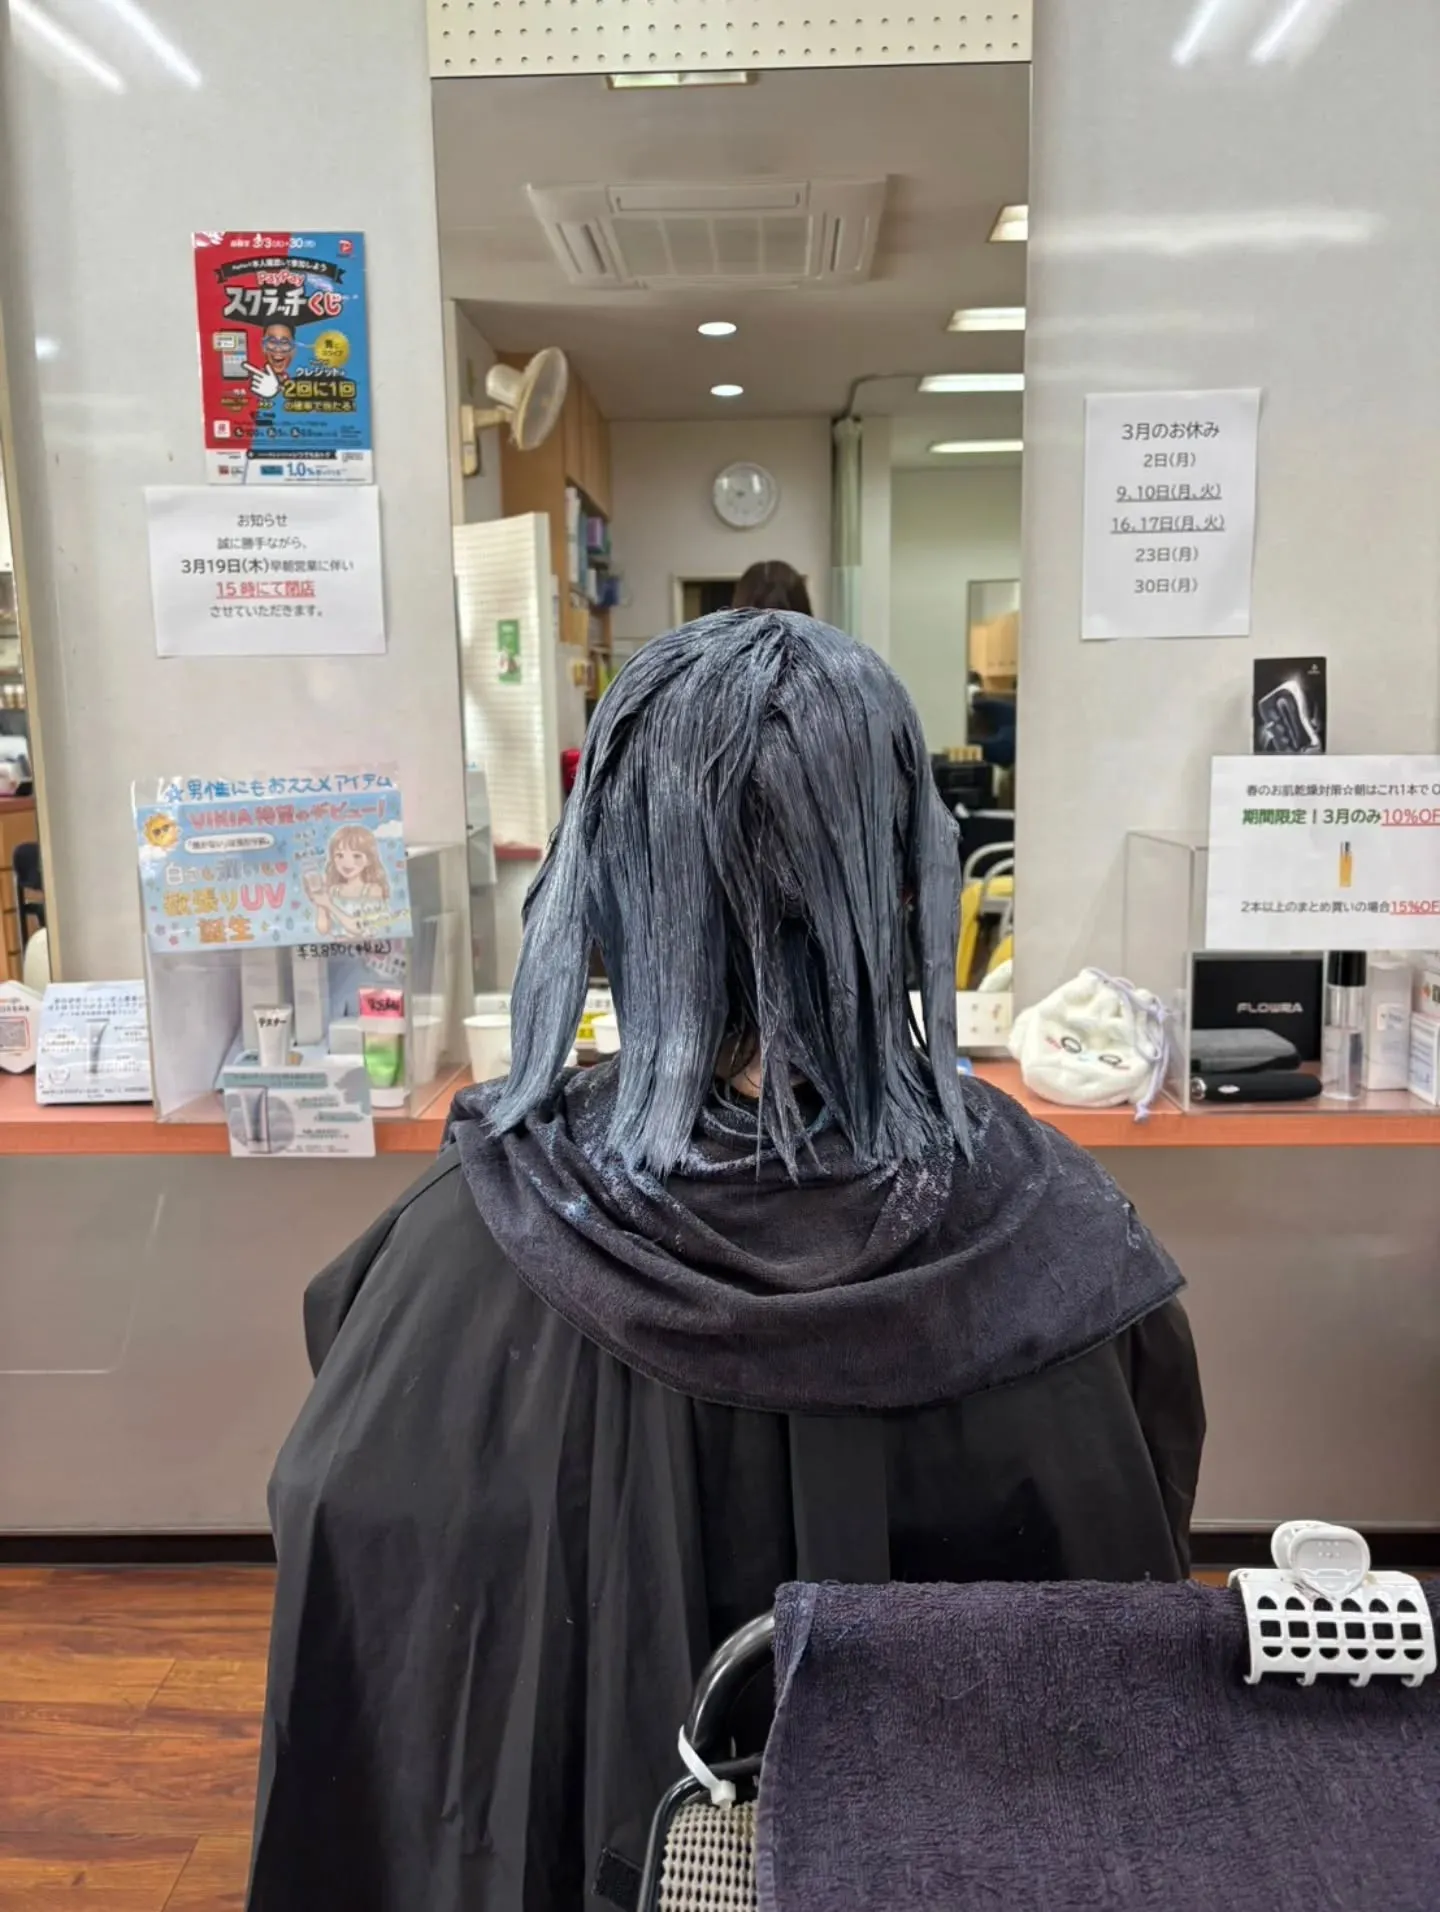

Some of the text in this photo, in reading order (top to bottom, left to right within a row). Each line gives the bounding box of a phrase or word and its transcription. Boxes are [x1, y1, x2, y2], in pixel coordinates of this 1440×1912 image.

[256, 270, 305, 288] PayPay
[223, 286, 343, 318] スクラッチくじ
[1121, 421, 1220, 441] 3月のお休み
[1143, 451, 1197, 468] 2日(月)
[237, 513, 288, 528] お知らせ
[217, 536, 308, 551] 誠に勝手ながら、
[1135, 547, 1199, 563] 23日(月)
[1134, 577, 1198, 594] 30日(月)
[209, 604, 323, 618] させていただきます。
